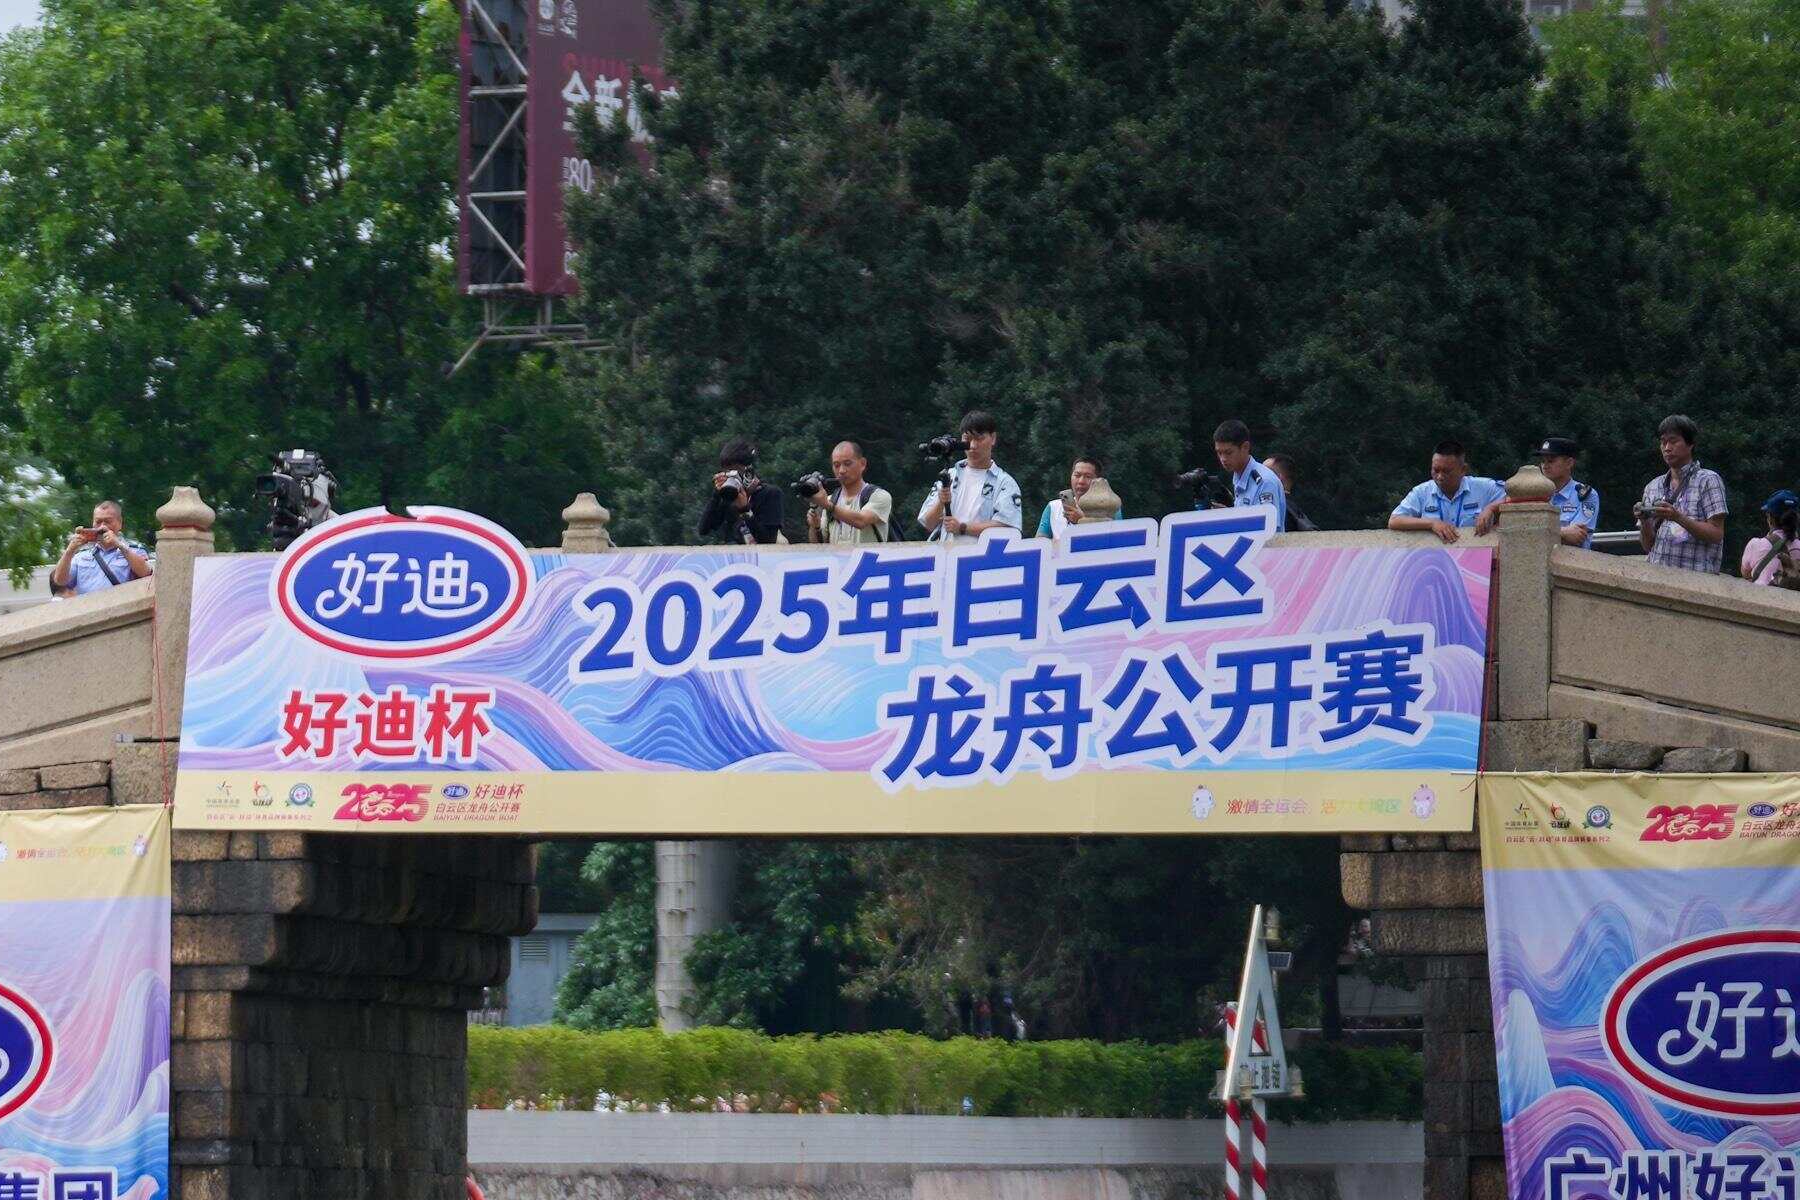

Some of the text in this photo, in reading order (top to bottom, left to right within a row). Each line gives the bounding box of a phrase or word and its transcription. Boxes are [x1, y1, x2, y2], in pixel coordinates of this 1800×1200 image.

[315, 551, 488, 618] 好迪
[578, 515, 1266, 674] 2025年白云区
[280, 689, 492, 760] 好迪杯
[882, 632, 1424, 784] 龙舟公开赛
[474, 784, 524, 800] 好迪杯
